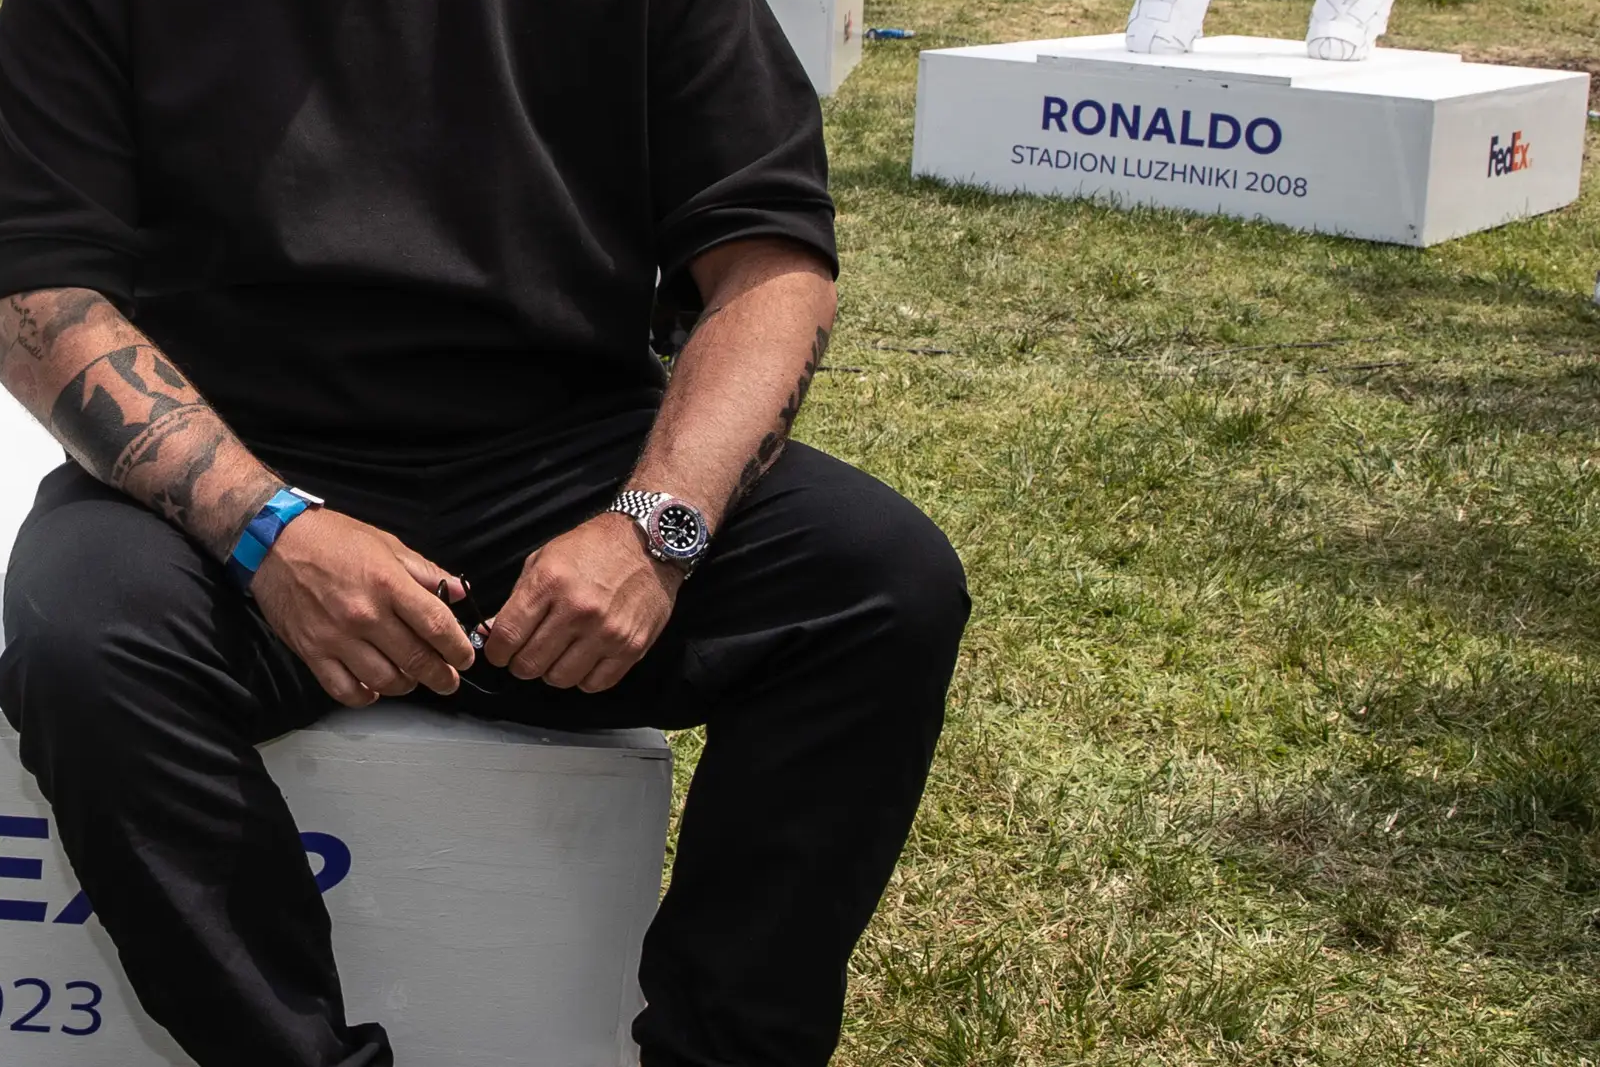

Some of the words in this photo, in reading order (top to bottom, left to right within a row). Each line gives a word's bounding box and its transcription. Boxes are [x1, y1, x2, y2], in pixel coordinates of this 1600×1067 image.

[1040, 95, 1283, 155] RONALDO
[1010, 144, 1117, 175] STADION
[1122, 156, 1239, 190] LUZHNIKI
[1244, 170, 1309, 198] 2008
[1486, 129, 1531, 178] FedEx
